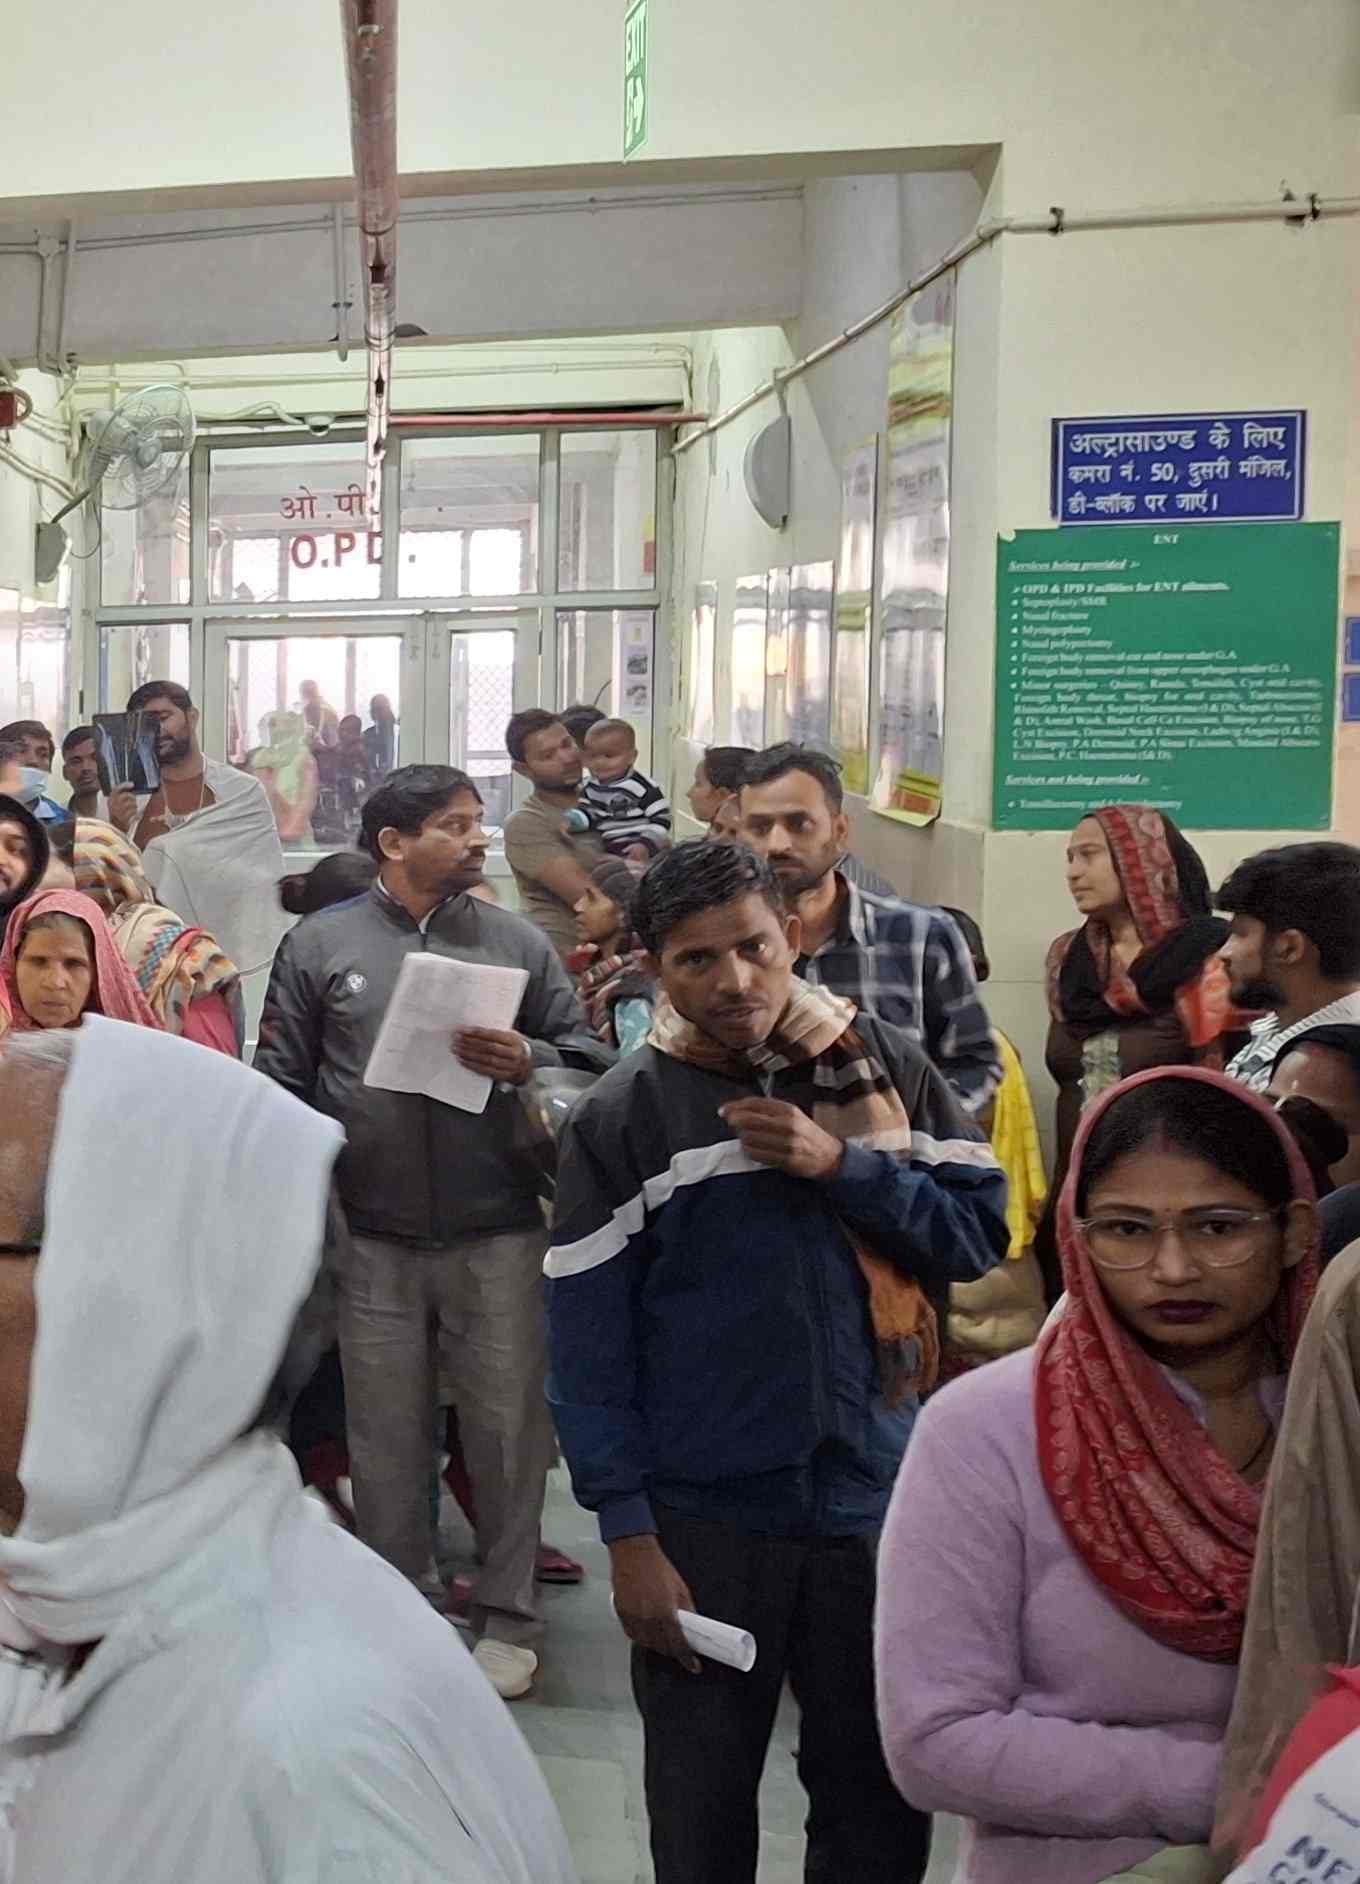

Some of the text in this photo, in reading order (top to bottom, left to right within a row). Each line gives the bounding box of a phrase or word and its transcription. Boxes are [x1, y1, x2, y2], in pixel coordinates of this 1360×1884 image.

[1070, 422, 1286, 458] अल्ट्रासाउण्ड के लिए
[1068, 464, 1112, 483] कमरा
[1151, 462, 1179, 484] 50,
[1188, 456, 1231, 487] दुसरी
[1068, 490, 1135, 514] डी-ब्लॉक
[1145, 494, 1168, 514] पर
[1153, 534, 1179, 545] ENT
[1022, 584, 1048, 595] OPD
